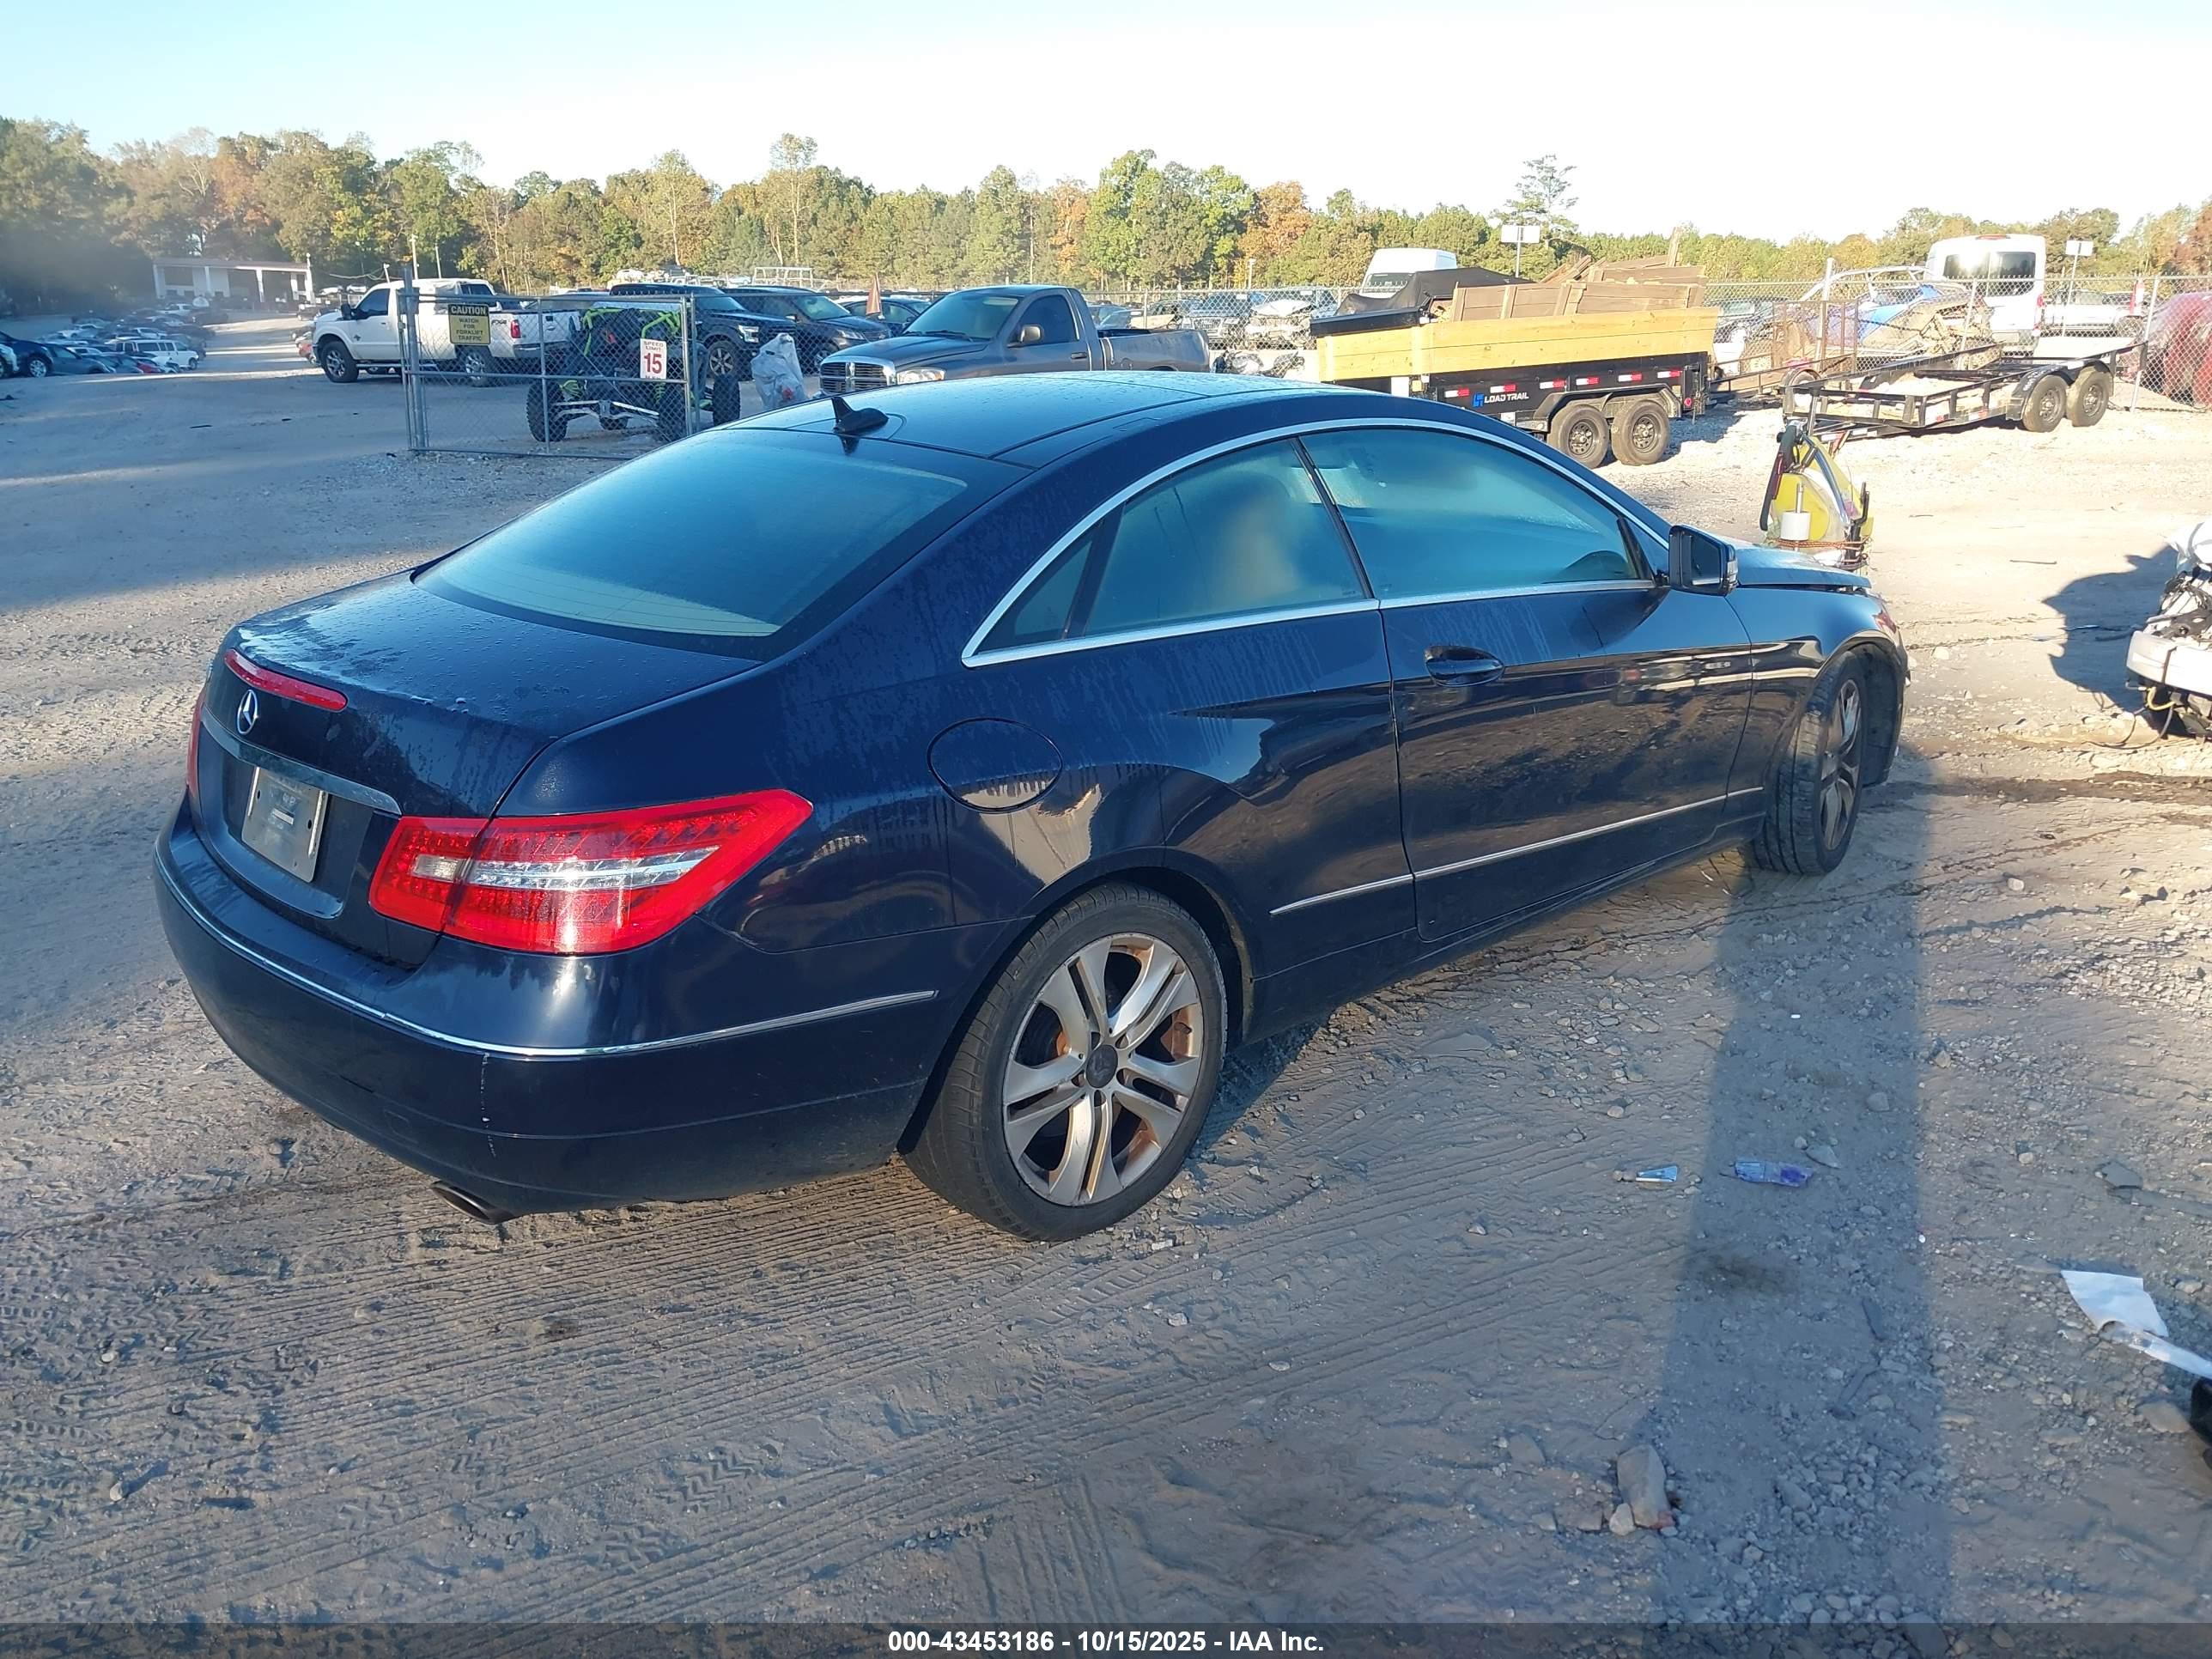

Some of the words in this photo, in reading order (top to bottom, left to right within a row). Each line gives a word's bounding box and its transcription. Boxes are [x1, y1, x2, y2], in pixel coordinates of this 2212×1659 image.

[451, 306, 486, 315] CAUTION
[644, 352, 662, 374] 15
[1484, 395, 1506, 404] LOAD
[1507, 392, 1529, 401] TRAIL
